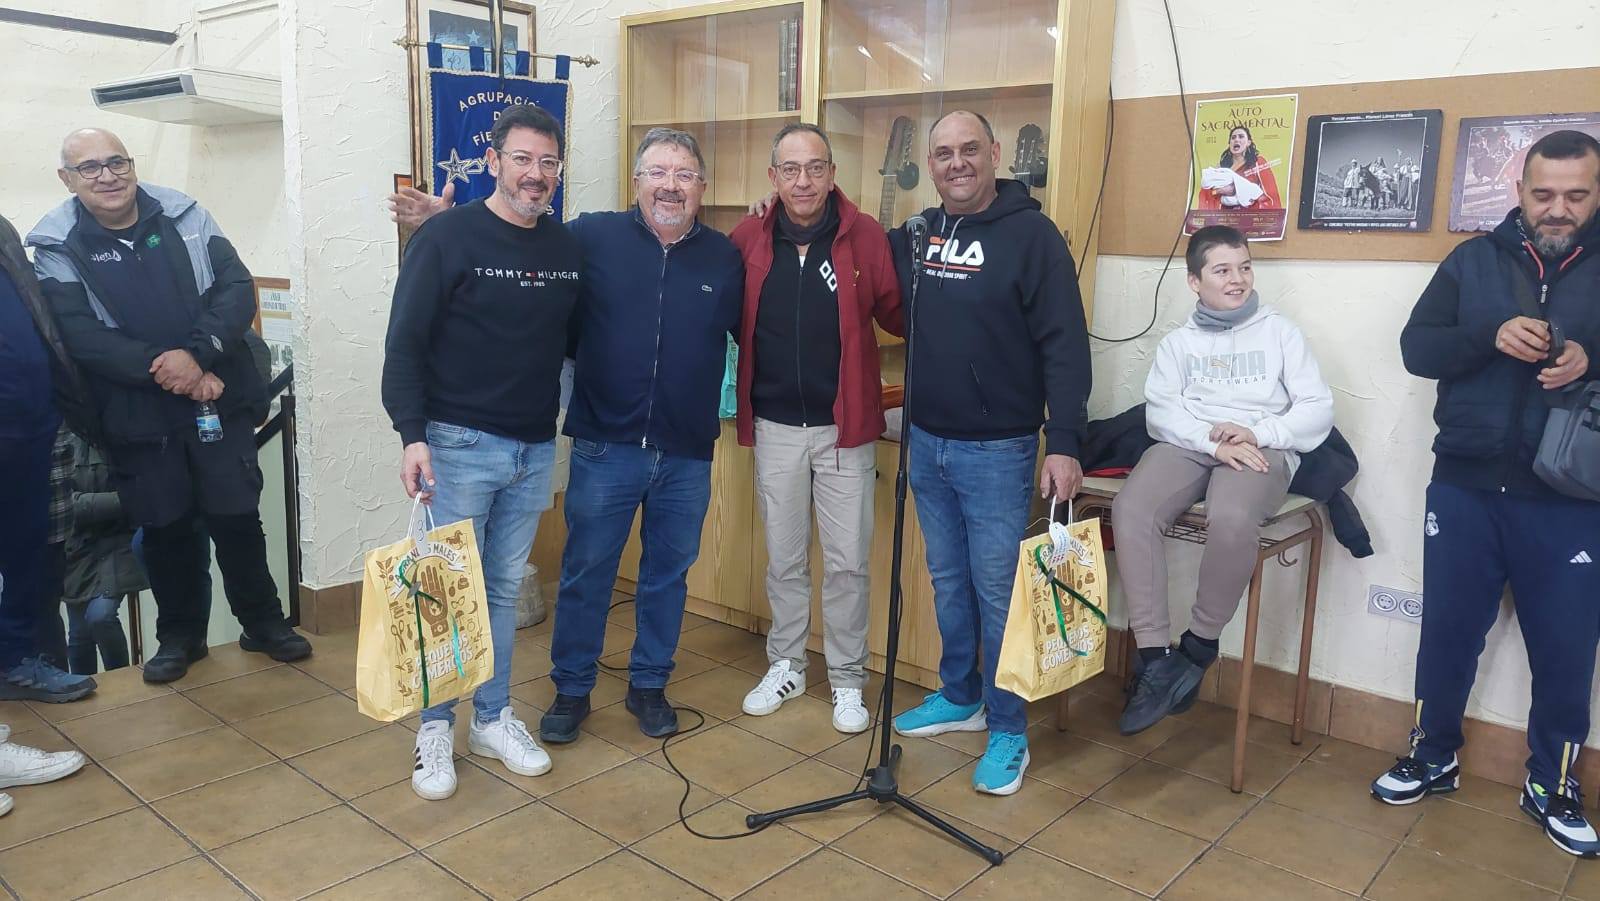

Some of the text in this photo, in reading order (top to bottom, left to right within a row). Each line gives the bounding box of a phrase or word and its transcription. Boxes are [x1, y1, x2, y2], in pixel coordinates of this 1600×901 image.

[1228, 106, 1262, 119] AUTO
[1201, 117, 1290, 132] SACRAMENTAL
[926, 236, 985, 266] FILA
[474, 267, 579, 280] TOMMY HILFIGER
[1183, 350, 1266, 379] PUMA
